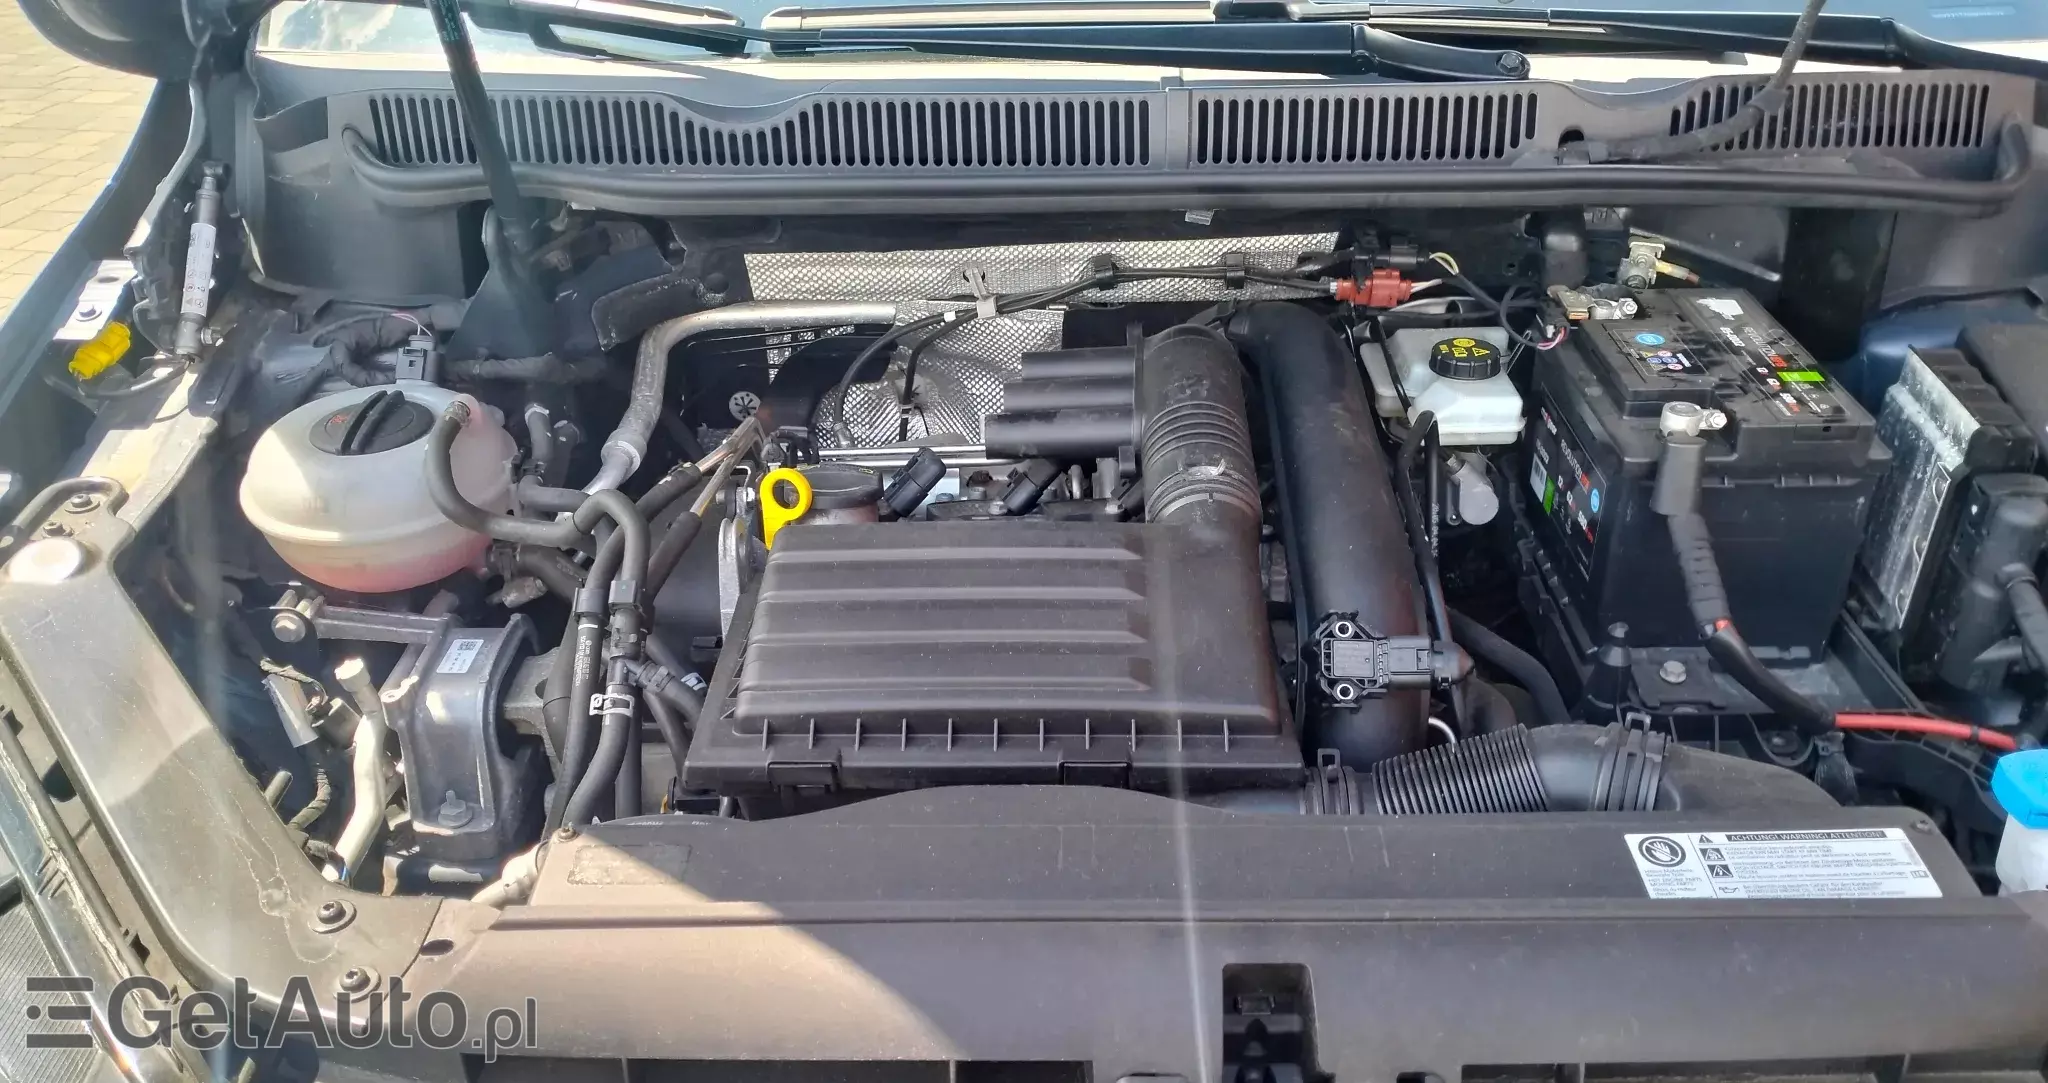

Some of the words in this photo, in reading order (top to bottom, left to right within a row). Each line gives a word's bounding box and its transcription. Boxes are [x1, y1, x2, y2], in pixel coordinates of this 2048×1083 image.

[1560, 438, 1583, 479] REVOLUTION
[1730, 833, 1779, 841] ACHTUNG!
[1780, 832, 1828, 841] WARNING!
[1829, 830, 1884, 839] ATTENTION!
